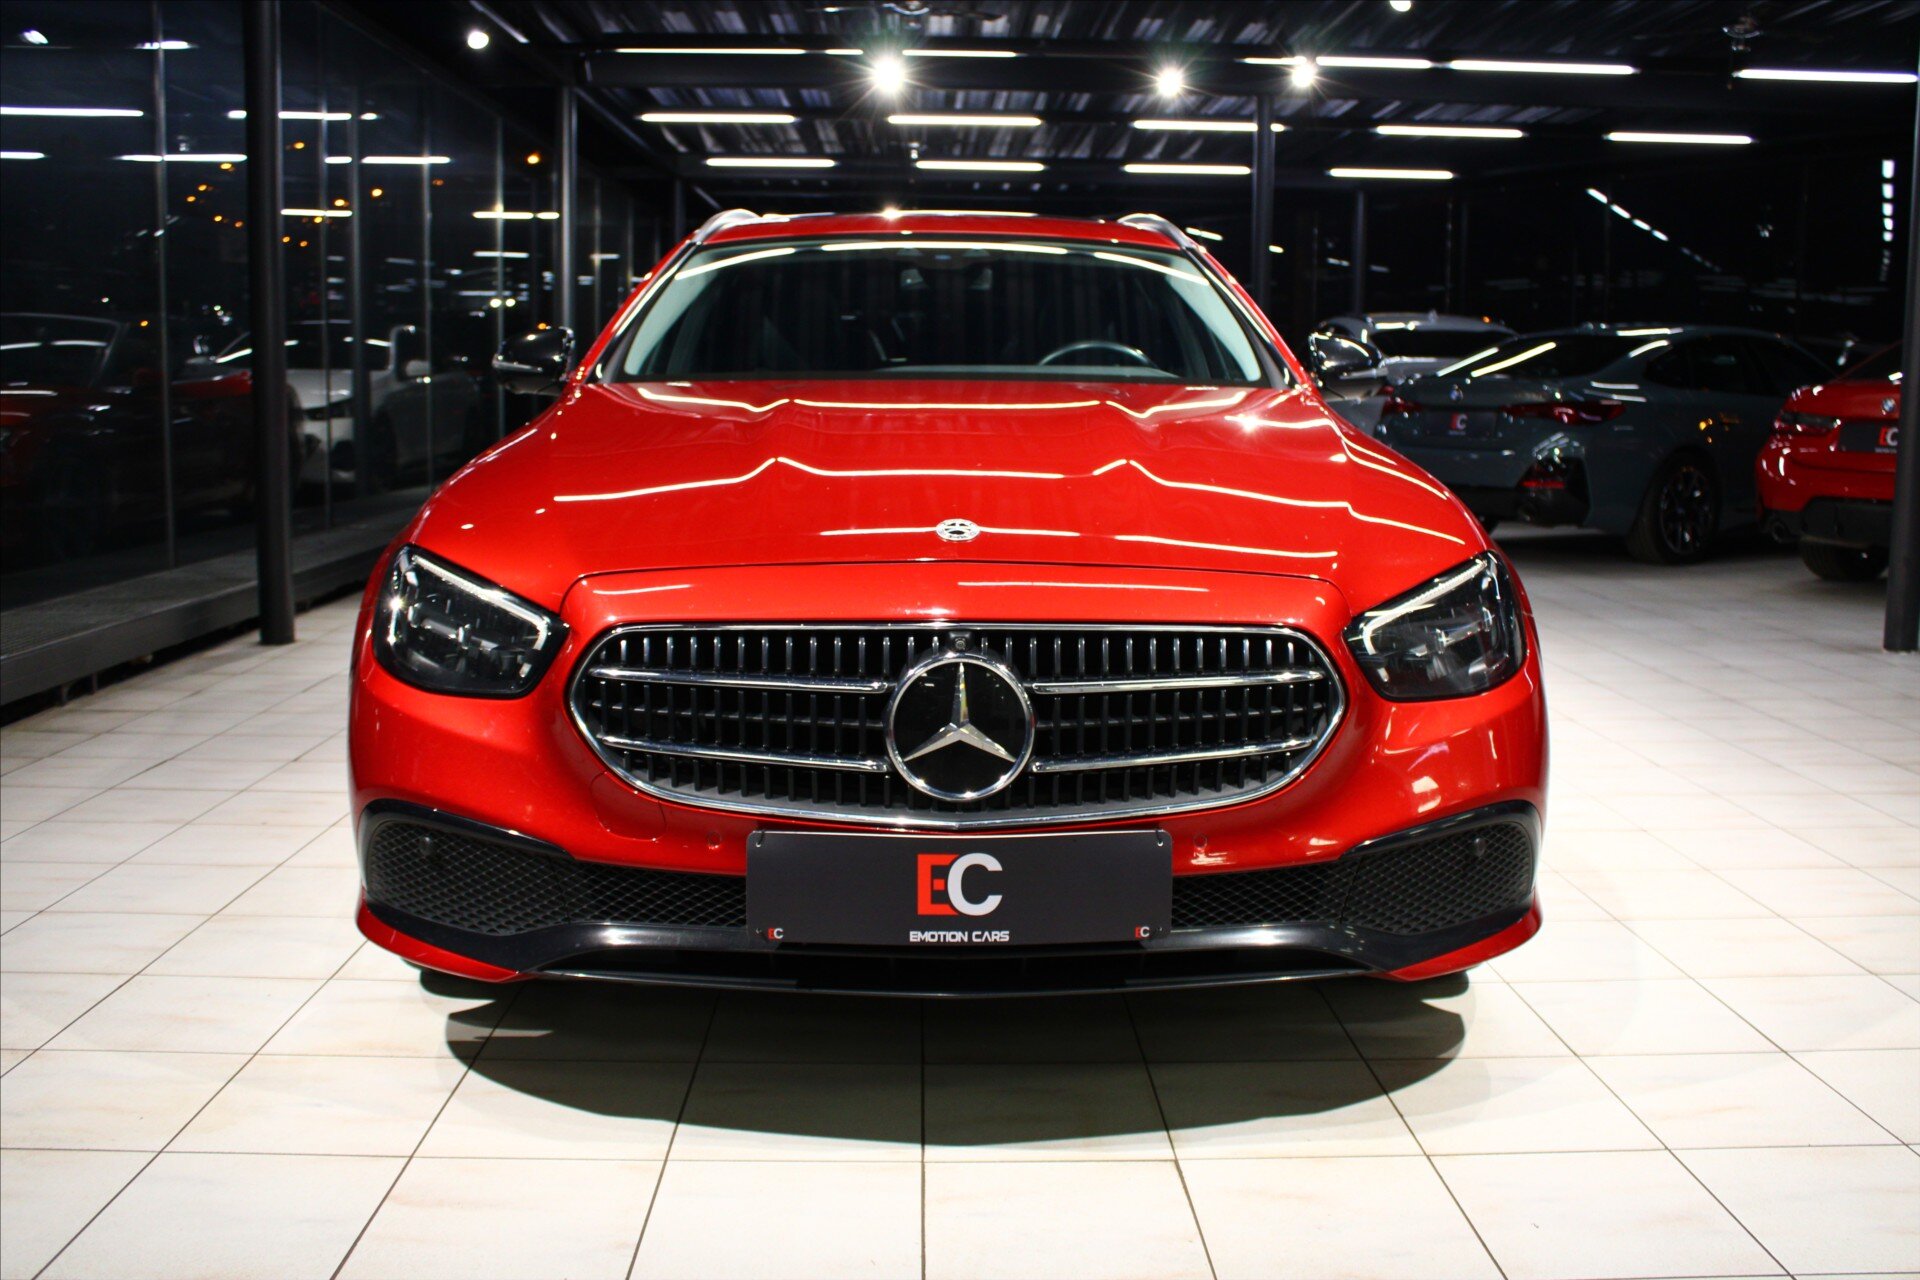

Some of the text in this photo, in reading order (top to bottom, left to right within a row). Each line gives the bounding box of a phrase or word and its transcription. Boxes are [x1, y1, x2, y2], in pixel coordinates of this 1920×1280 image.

[917, 852, 1003, 916] EC
[768, 927, 784, 940] EC
[909, 931, 1010, 942] EMOTION CARS
[1135, 926, 1150, 939] EC
